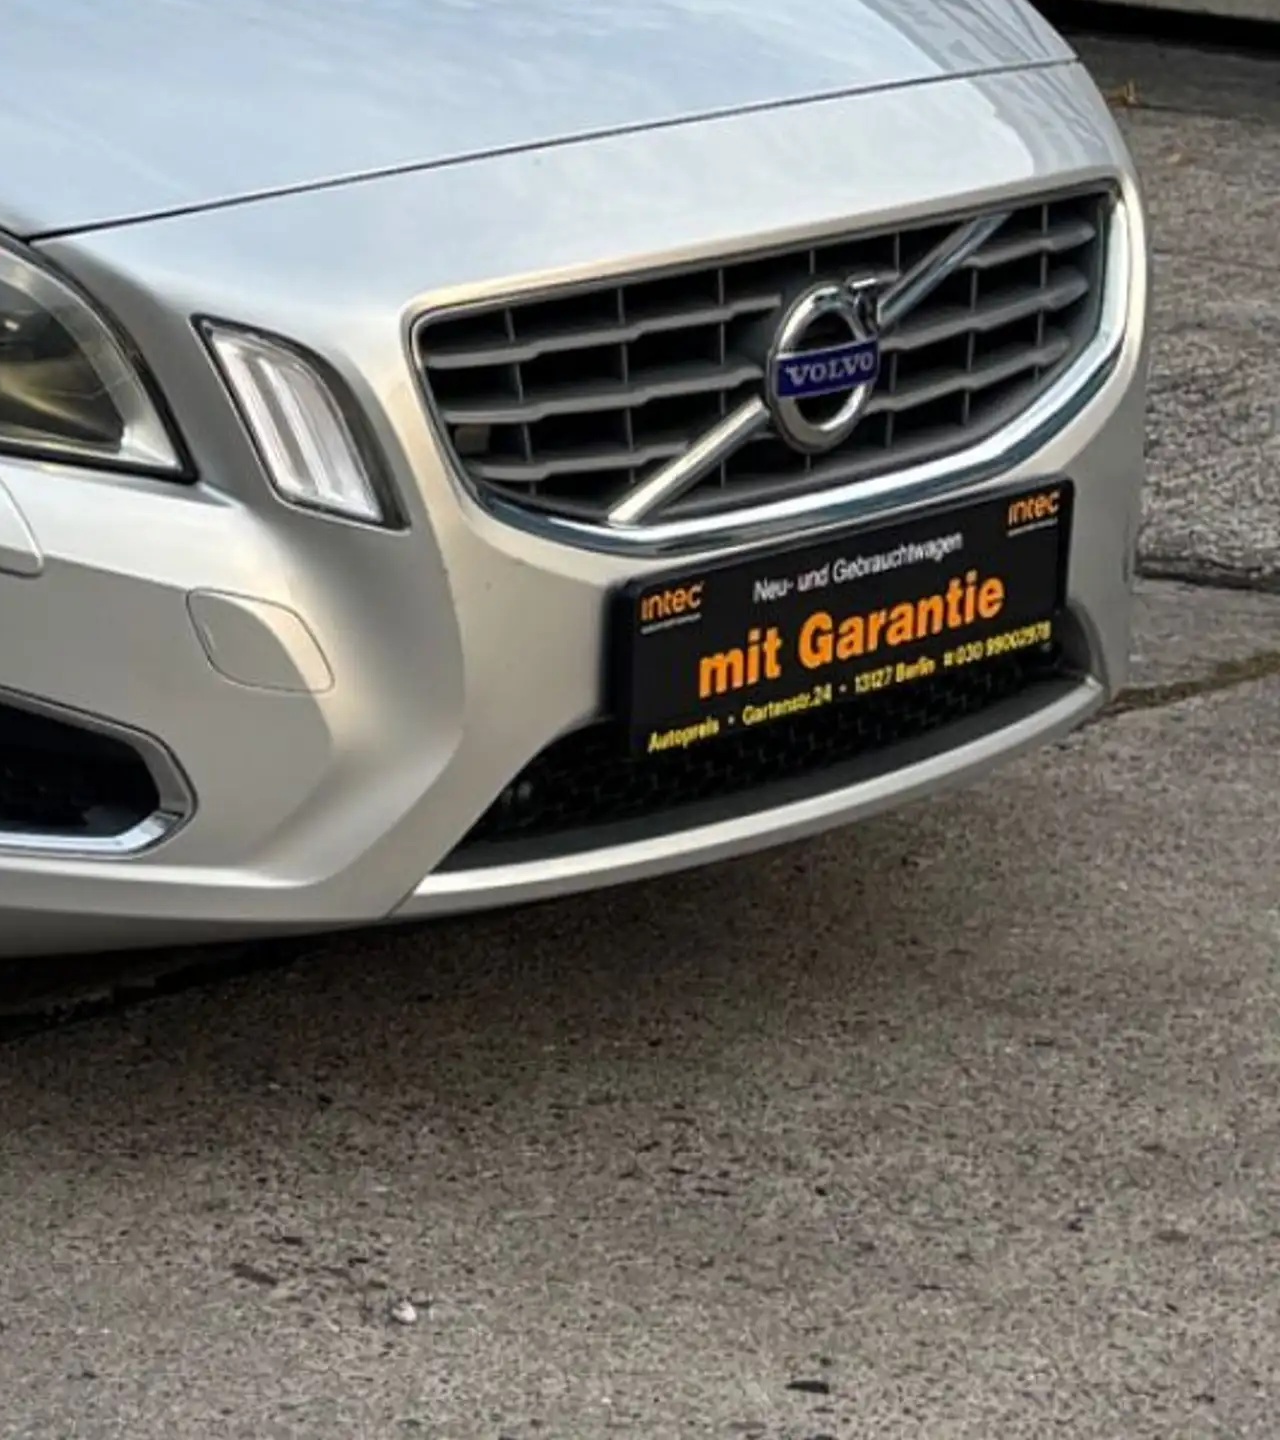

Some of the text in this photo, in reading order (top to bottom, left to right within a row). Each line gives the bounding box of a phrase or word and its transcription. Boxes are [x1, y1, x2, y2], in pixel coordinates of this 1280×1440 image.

[785, 351, 874, 387] VOLVO
[753, 531, 964, 603] Neu- und Gebrauchtwagen
[699, 567, 1006, 700] mit Garantie
[648, 715, 720, 754] Autopreis
[896, 655, 937, 684] Berlin
